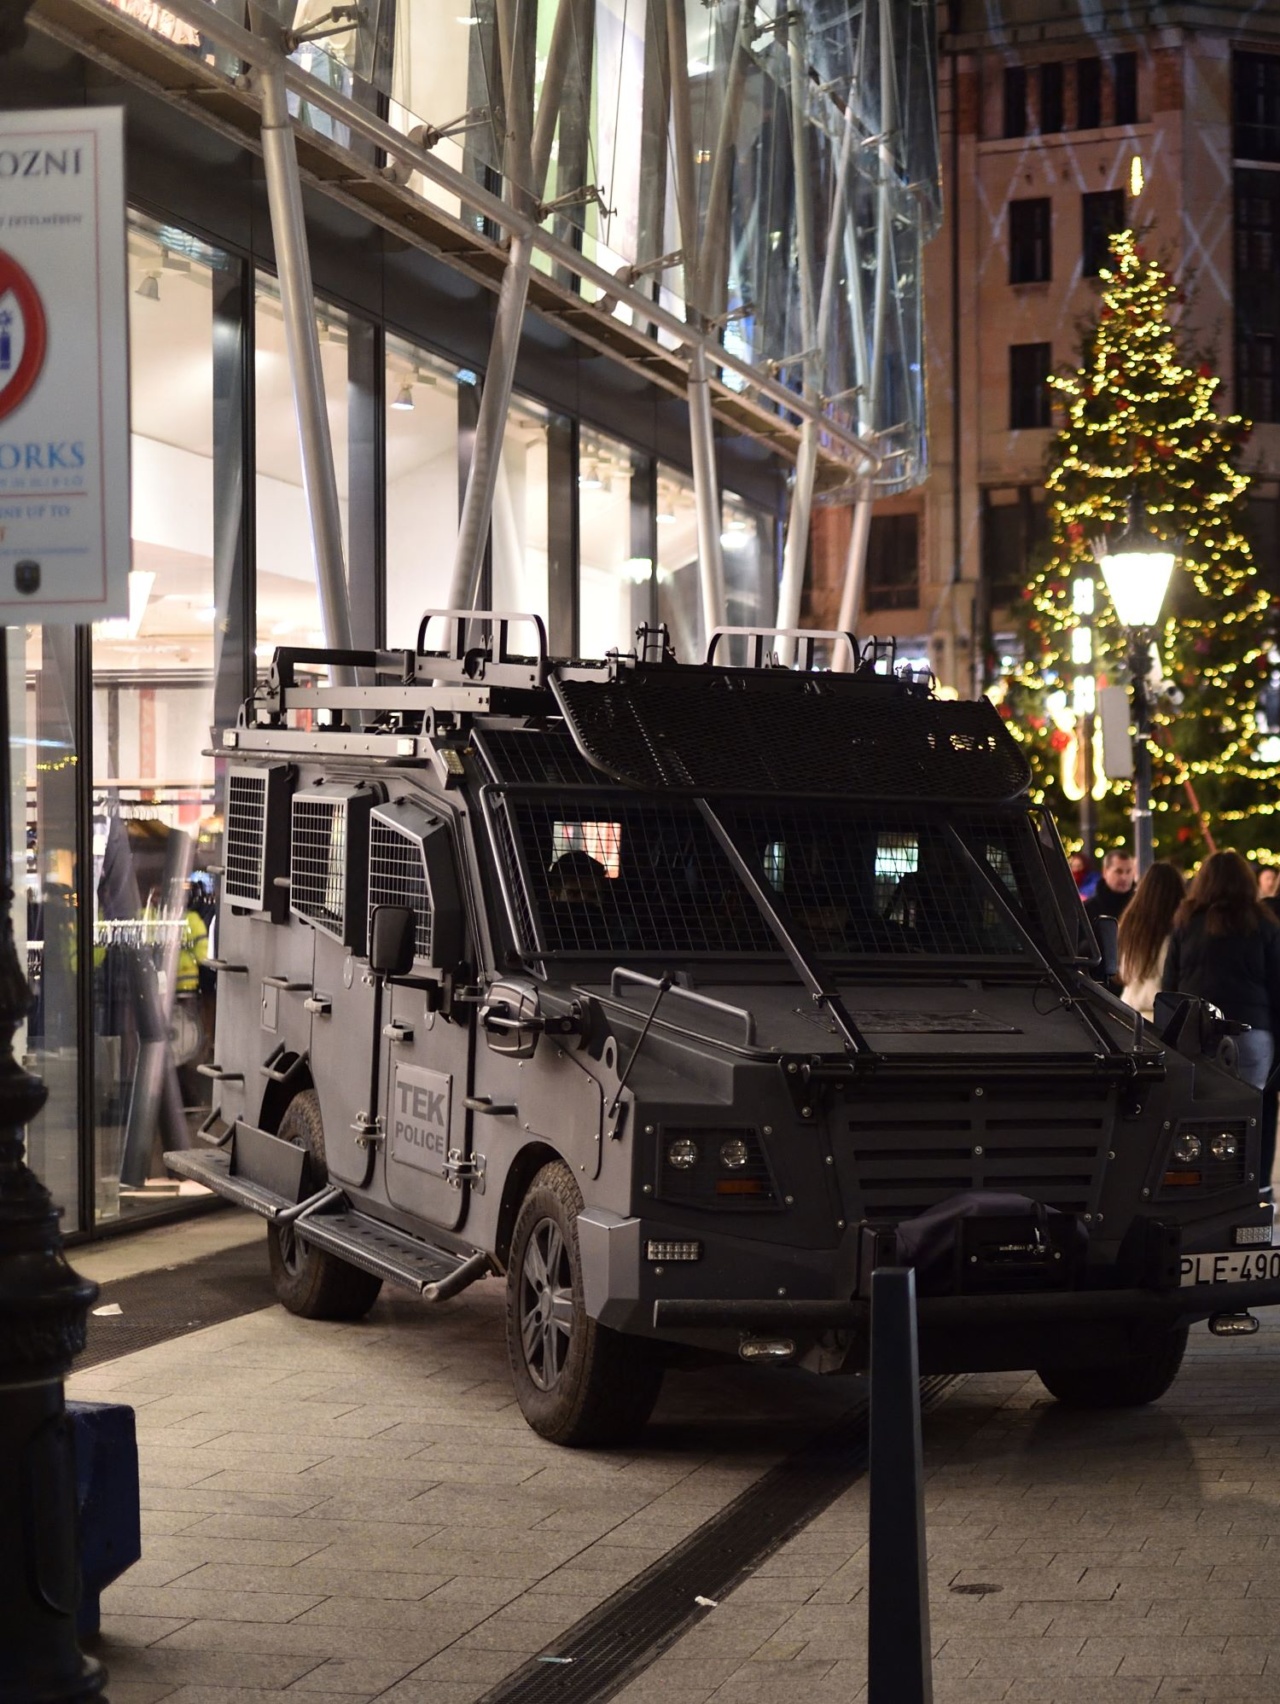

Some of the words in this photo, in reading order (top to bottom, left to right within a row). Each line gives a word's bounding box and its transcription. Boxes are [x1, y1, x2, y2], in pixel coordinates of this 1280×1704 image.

[0, 441, 85, 470] ORKS
[397, 1081, 445, 1127] TEK
[395, 1121, 444, 1155] POLICE
